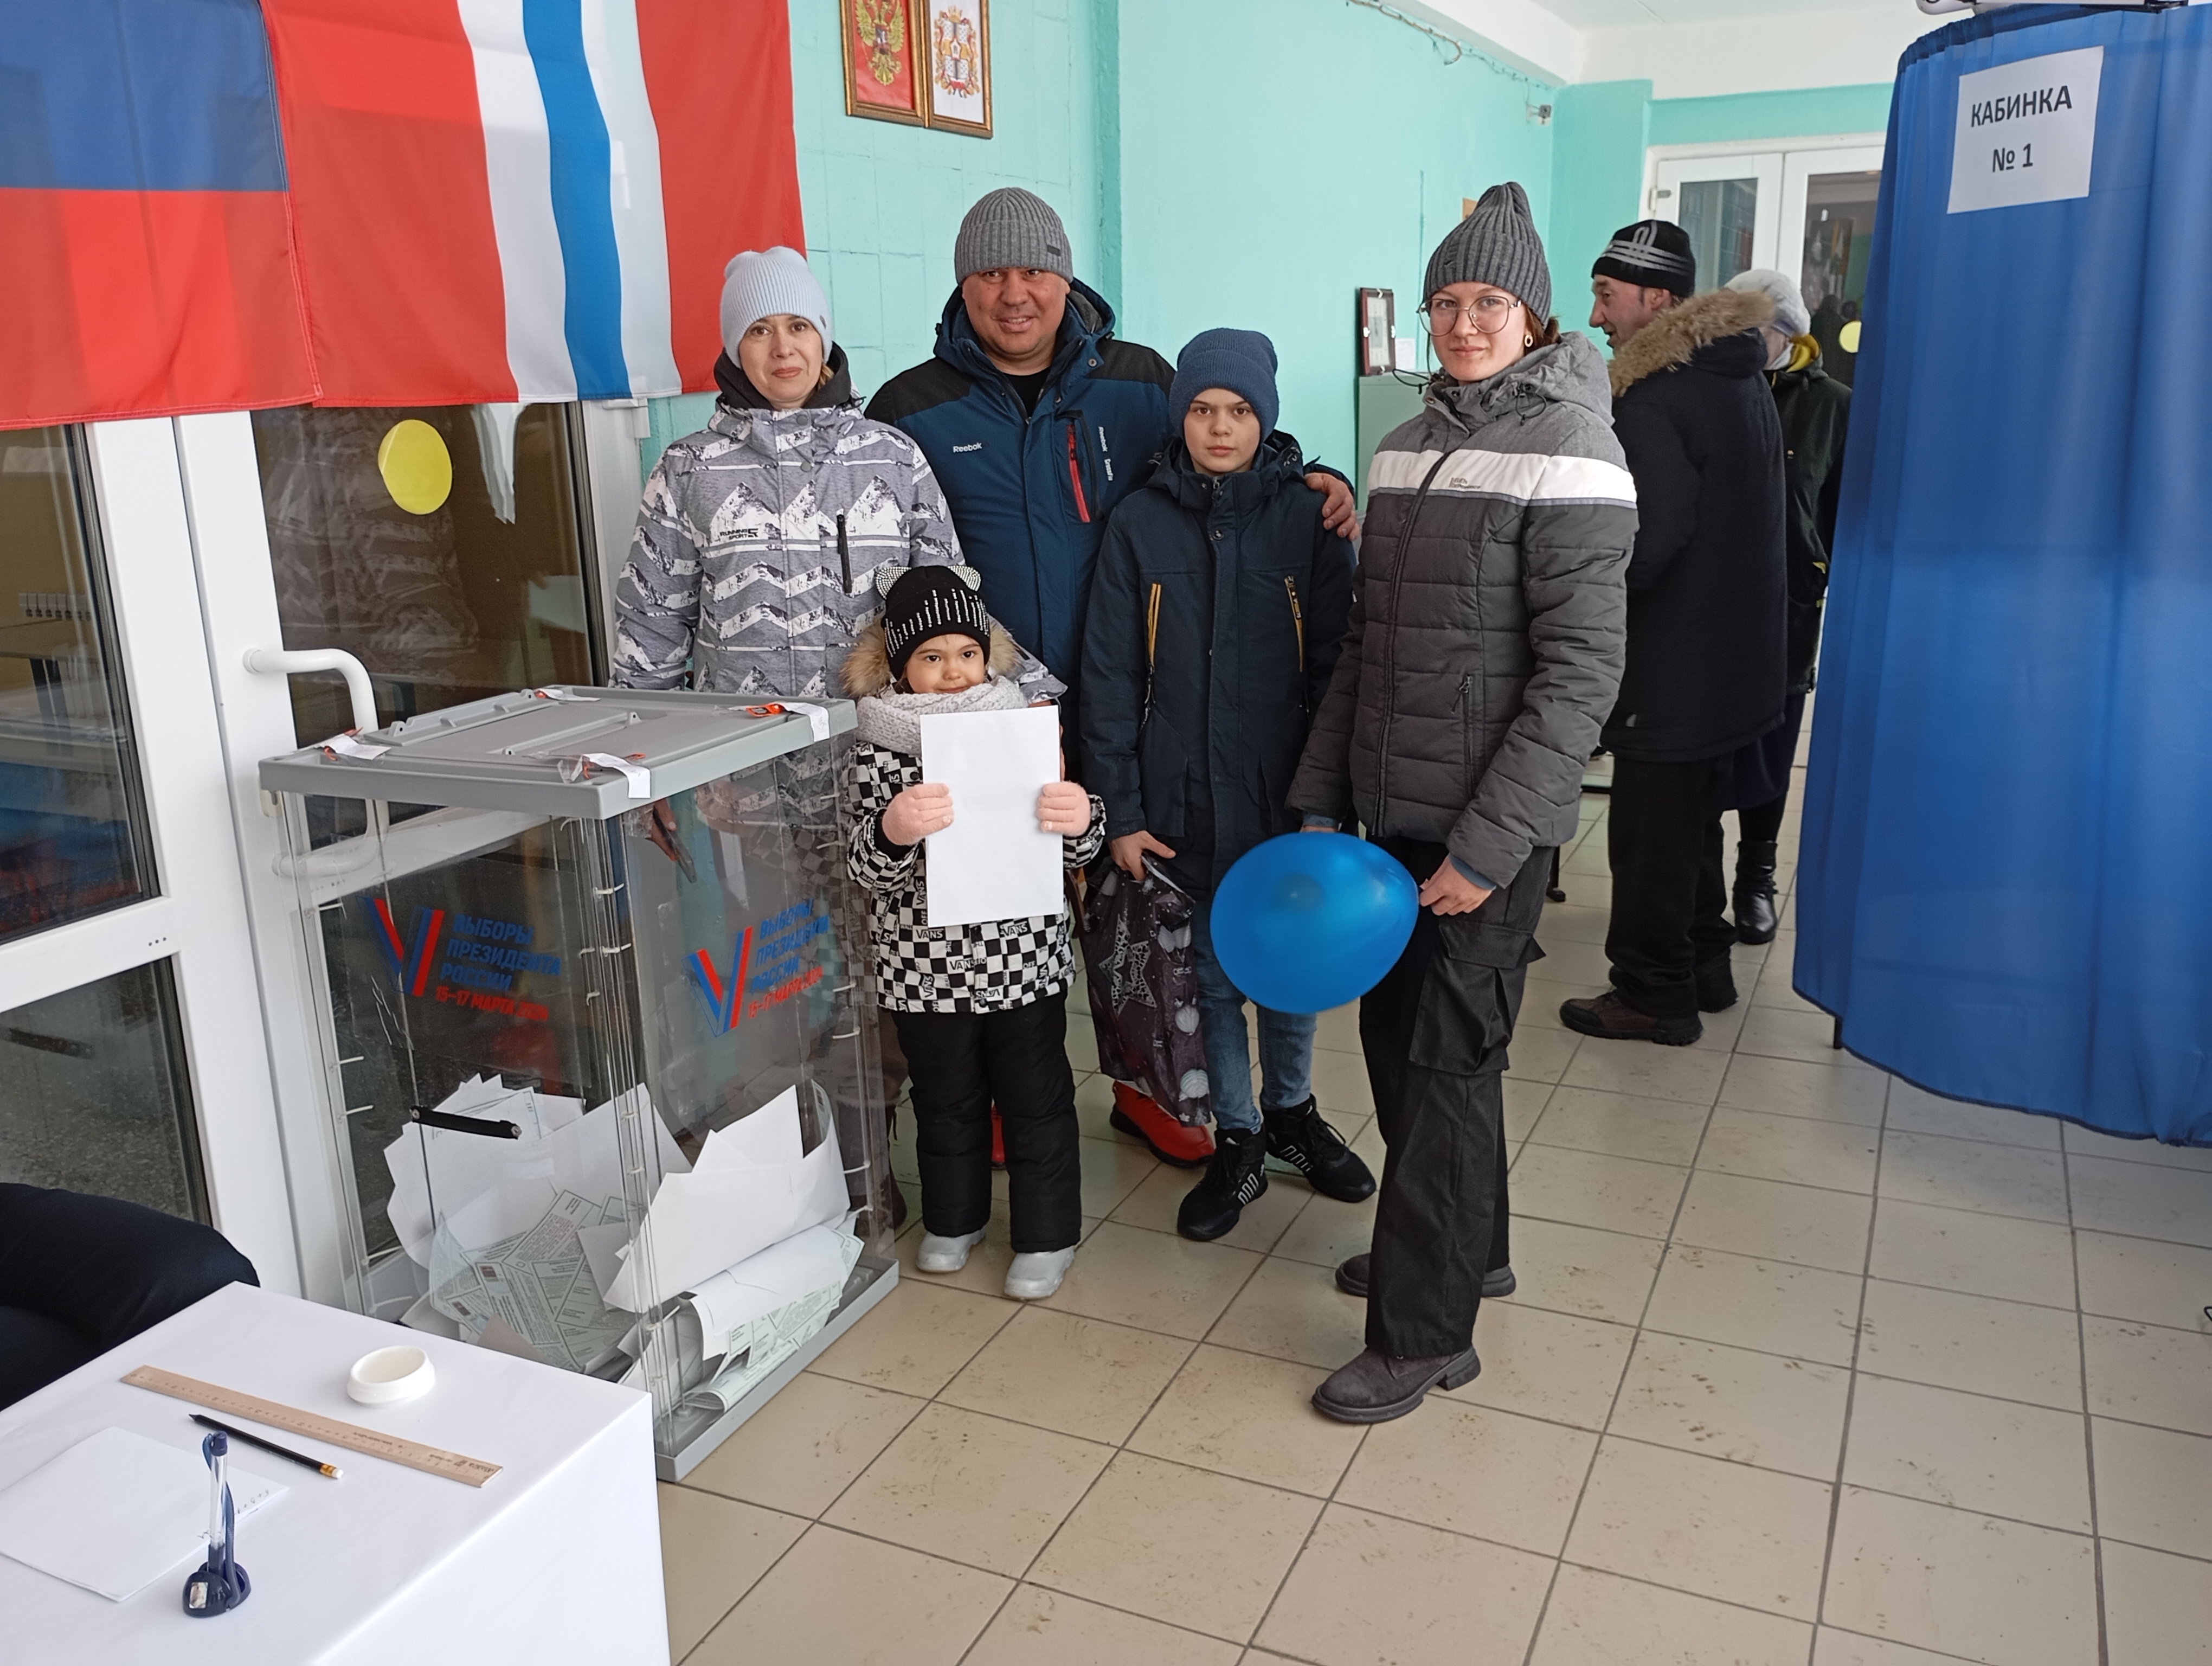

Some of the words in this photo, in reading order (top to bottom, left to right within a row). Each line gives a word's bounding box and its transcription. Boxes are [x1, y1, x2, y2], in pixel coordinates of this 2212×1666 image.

[1971, 85, 2072, 127] КАБИНКА
[1991, 147, 2015, 173] №
[2022, 143, 2034, 168] 1
[953, 442, 982, 453] Reebok
[916, 879, 927, 906] VANS
[454, 914, 535, 944] ВЫБОРЫ
[916, 928, 944, 939] VANS
[1002, 922, 1028, 937] VANS
[447, 939, 561, 975] ПРЕЗИДЕНТА
[949, 959, 975, 971] VANS
[1023, 961, 1036, 969] OFF
[441, 964, 512, 991] РОССИИ
[751, 956, 800, 994] РОССИИ
[923, 974, 934, 998] VANS
[472, 994, 515, 1014] МАРТА
